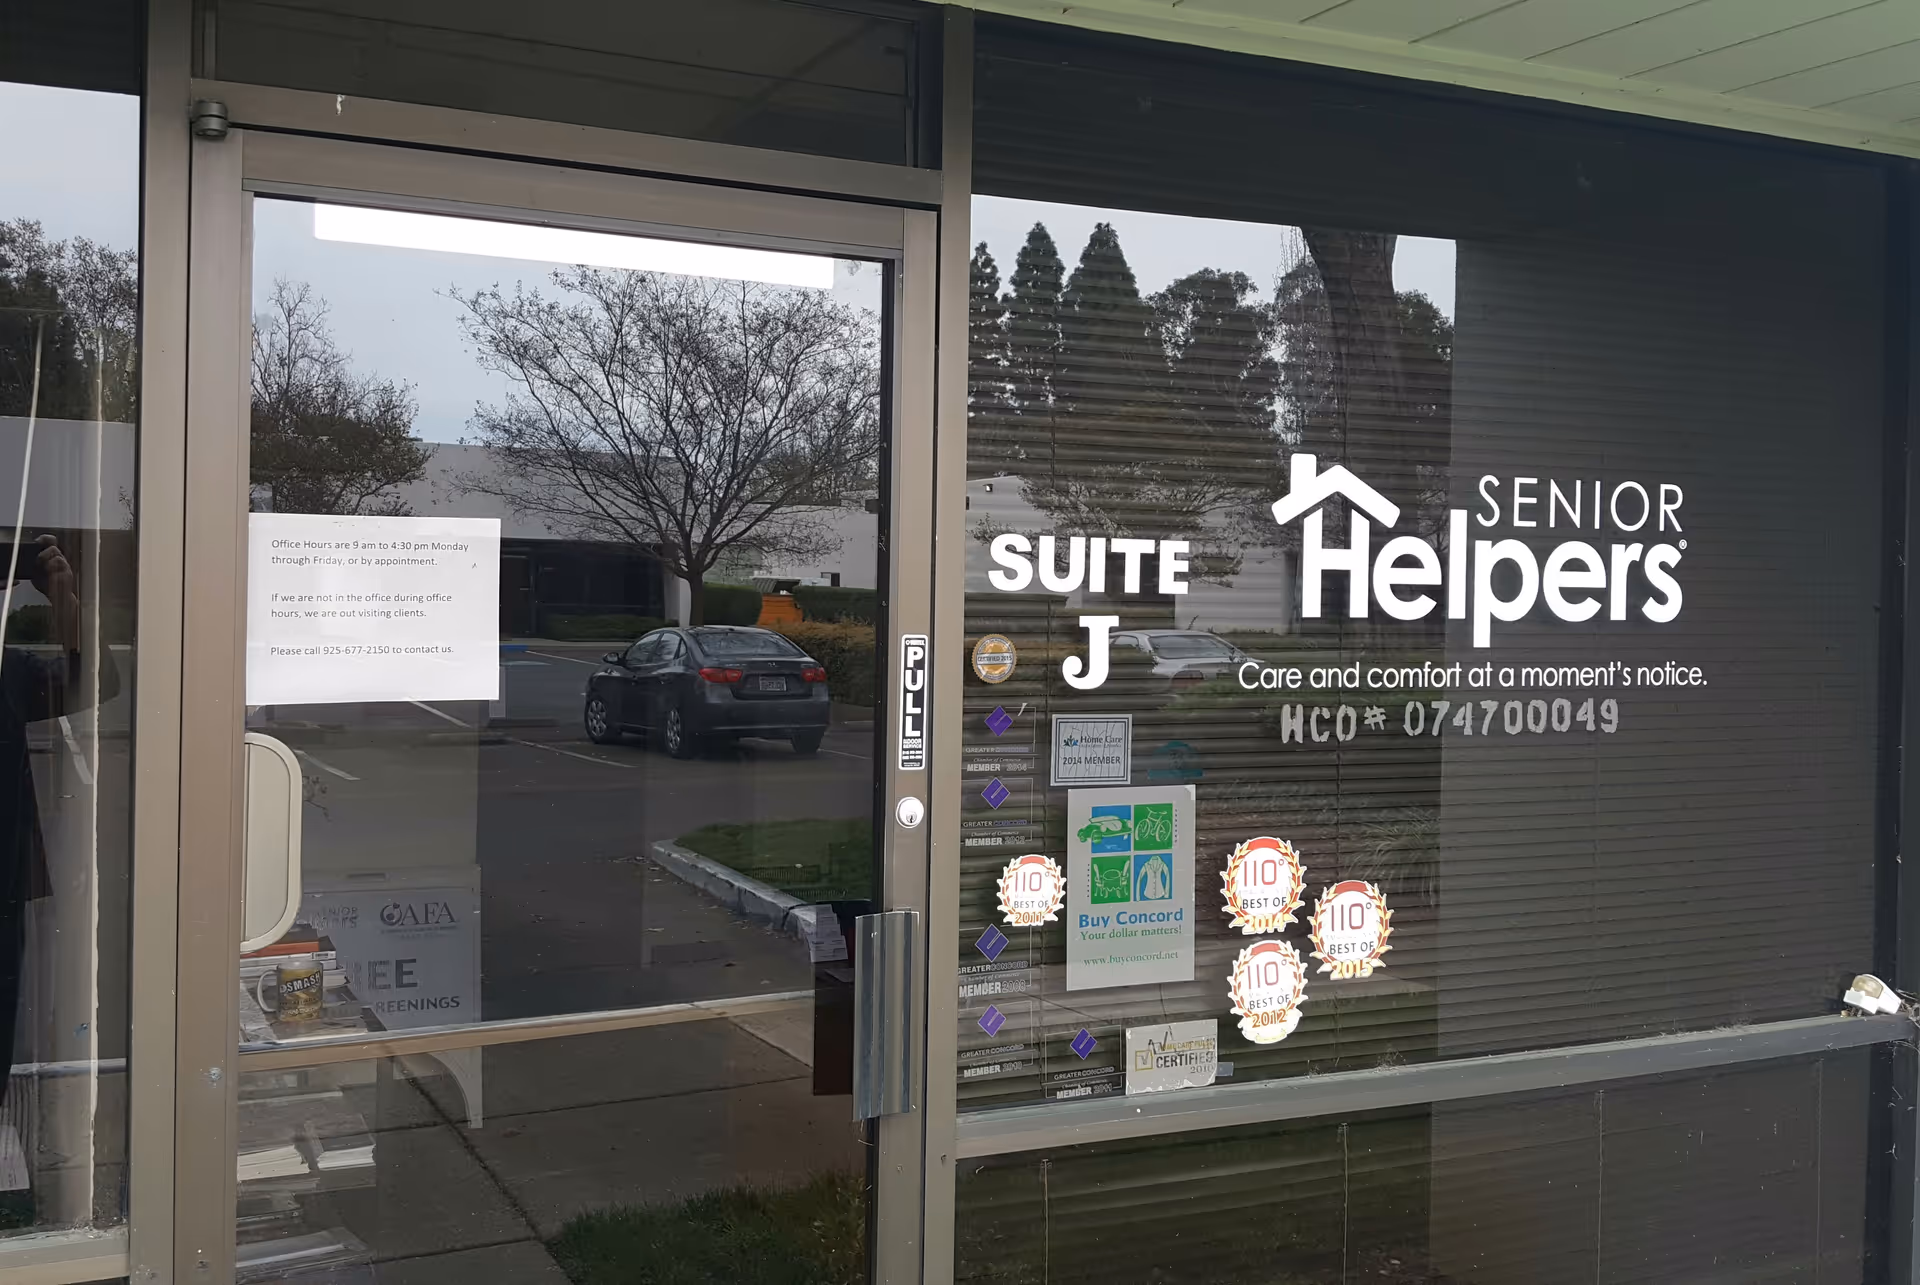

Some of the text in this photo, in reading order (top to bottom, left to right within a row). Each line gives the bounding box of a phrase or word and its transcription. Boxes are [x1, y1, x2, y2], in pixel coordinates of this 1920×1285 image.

[1476, 474, 1684, 533] SENIOR
[271, 539, 301, 549] Office
[303, 540, 332, 549] Hours
[353, 540, 359, 549] 9
[379, 541, 389, 549] to
[391, 541, 411, 550] 4:30
[414, 543, 429, 551] pm
[431, 542, 469, 552] Monday
[271, 556, 310, 566] through
[313, 556, 345, 566] Friday,
[361, 556, 372, 566] by
[375, 557, 438, 566] appointment.
[987, 533, 1190, 595] SUITE
[1301, 507, 1684, 647] Helpers
[271, 593, 279, 602] If
[298, 594, 313, 602] are
[316, 594, 332, 602] not
[336, 593, 344, 602] in
[347, 593, 362, 602] the
[365, 592, 391, 602] office
[393, 593, 424, 603] during
[426, 592, 452, 602] office
[271, 609, 301, 618] hours,
[340, 609, 356, 617] out
[358, 608, 391, 619] visiting
[394, 608, 426, 617] clients.
[270, 646, 302, 655] Please
[304, 646, 321, 655] call
[323, 646, 389, 655] 925-677-2150
[392, 646, 402, 654] to
[404, 645, 439, 654] contact
[1062, 615, 1120, 690] J
[1238, 660, 1708, 689] Care and comfort at a moment's notice.
[904, 646, 925, 737] PULL
[1403, 697, 1619, 738] 074700049
[1080, 735, 1123, 744] Home Care
[966, 763, 1001, 772] MEMBER
[1062, 756, 1121, 765] 2014 MEMBER
[963, 820, 993, 828] GREATER
[964, 837, 1003, 847] MEMBER
[1013, 900, 1050, 909] BEST OF
[1242, 896, 1288, 910] BEST OF
[1014, 912, 1043, 924] 2011
[1078, 907, 1184, 929] Buy Concord
[1080, 924, 1183, 941] Your dollar matters!
[1329, 940, 1376, 955] BEST OF
[1082, 951, 1179, 966] www.buyconcord.net
[958, 981, 1002, 998] MEMBER
[376, 996, 460, 1013] REENINGS
[1248, 993, 1291, 1010] BEST OF
[1251, 1008, 1288, 1028] 2012
[961, 1049, 990, 1058] GREATER
[963, 1064, 1001, 1078] MEMBER
[1053, 1071, 1082, 1080] GREATER
[1056, 1086, 1092, 1099] MEMBER
